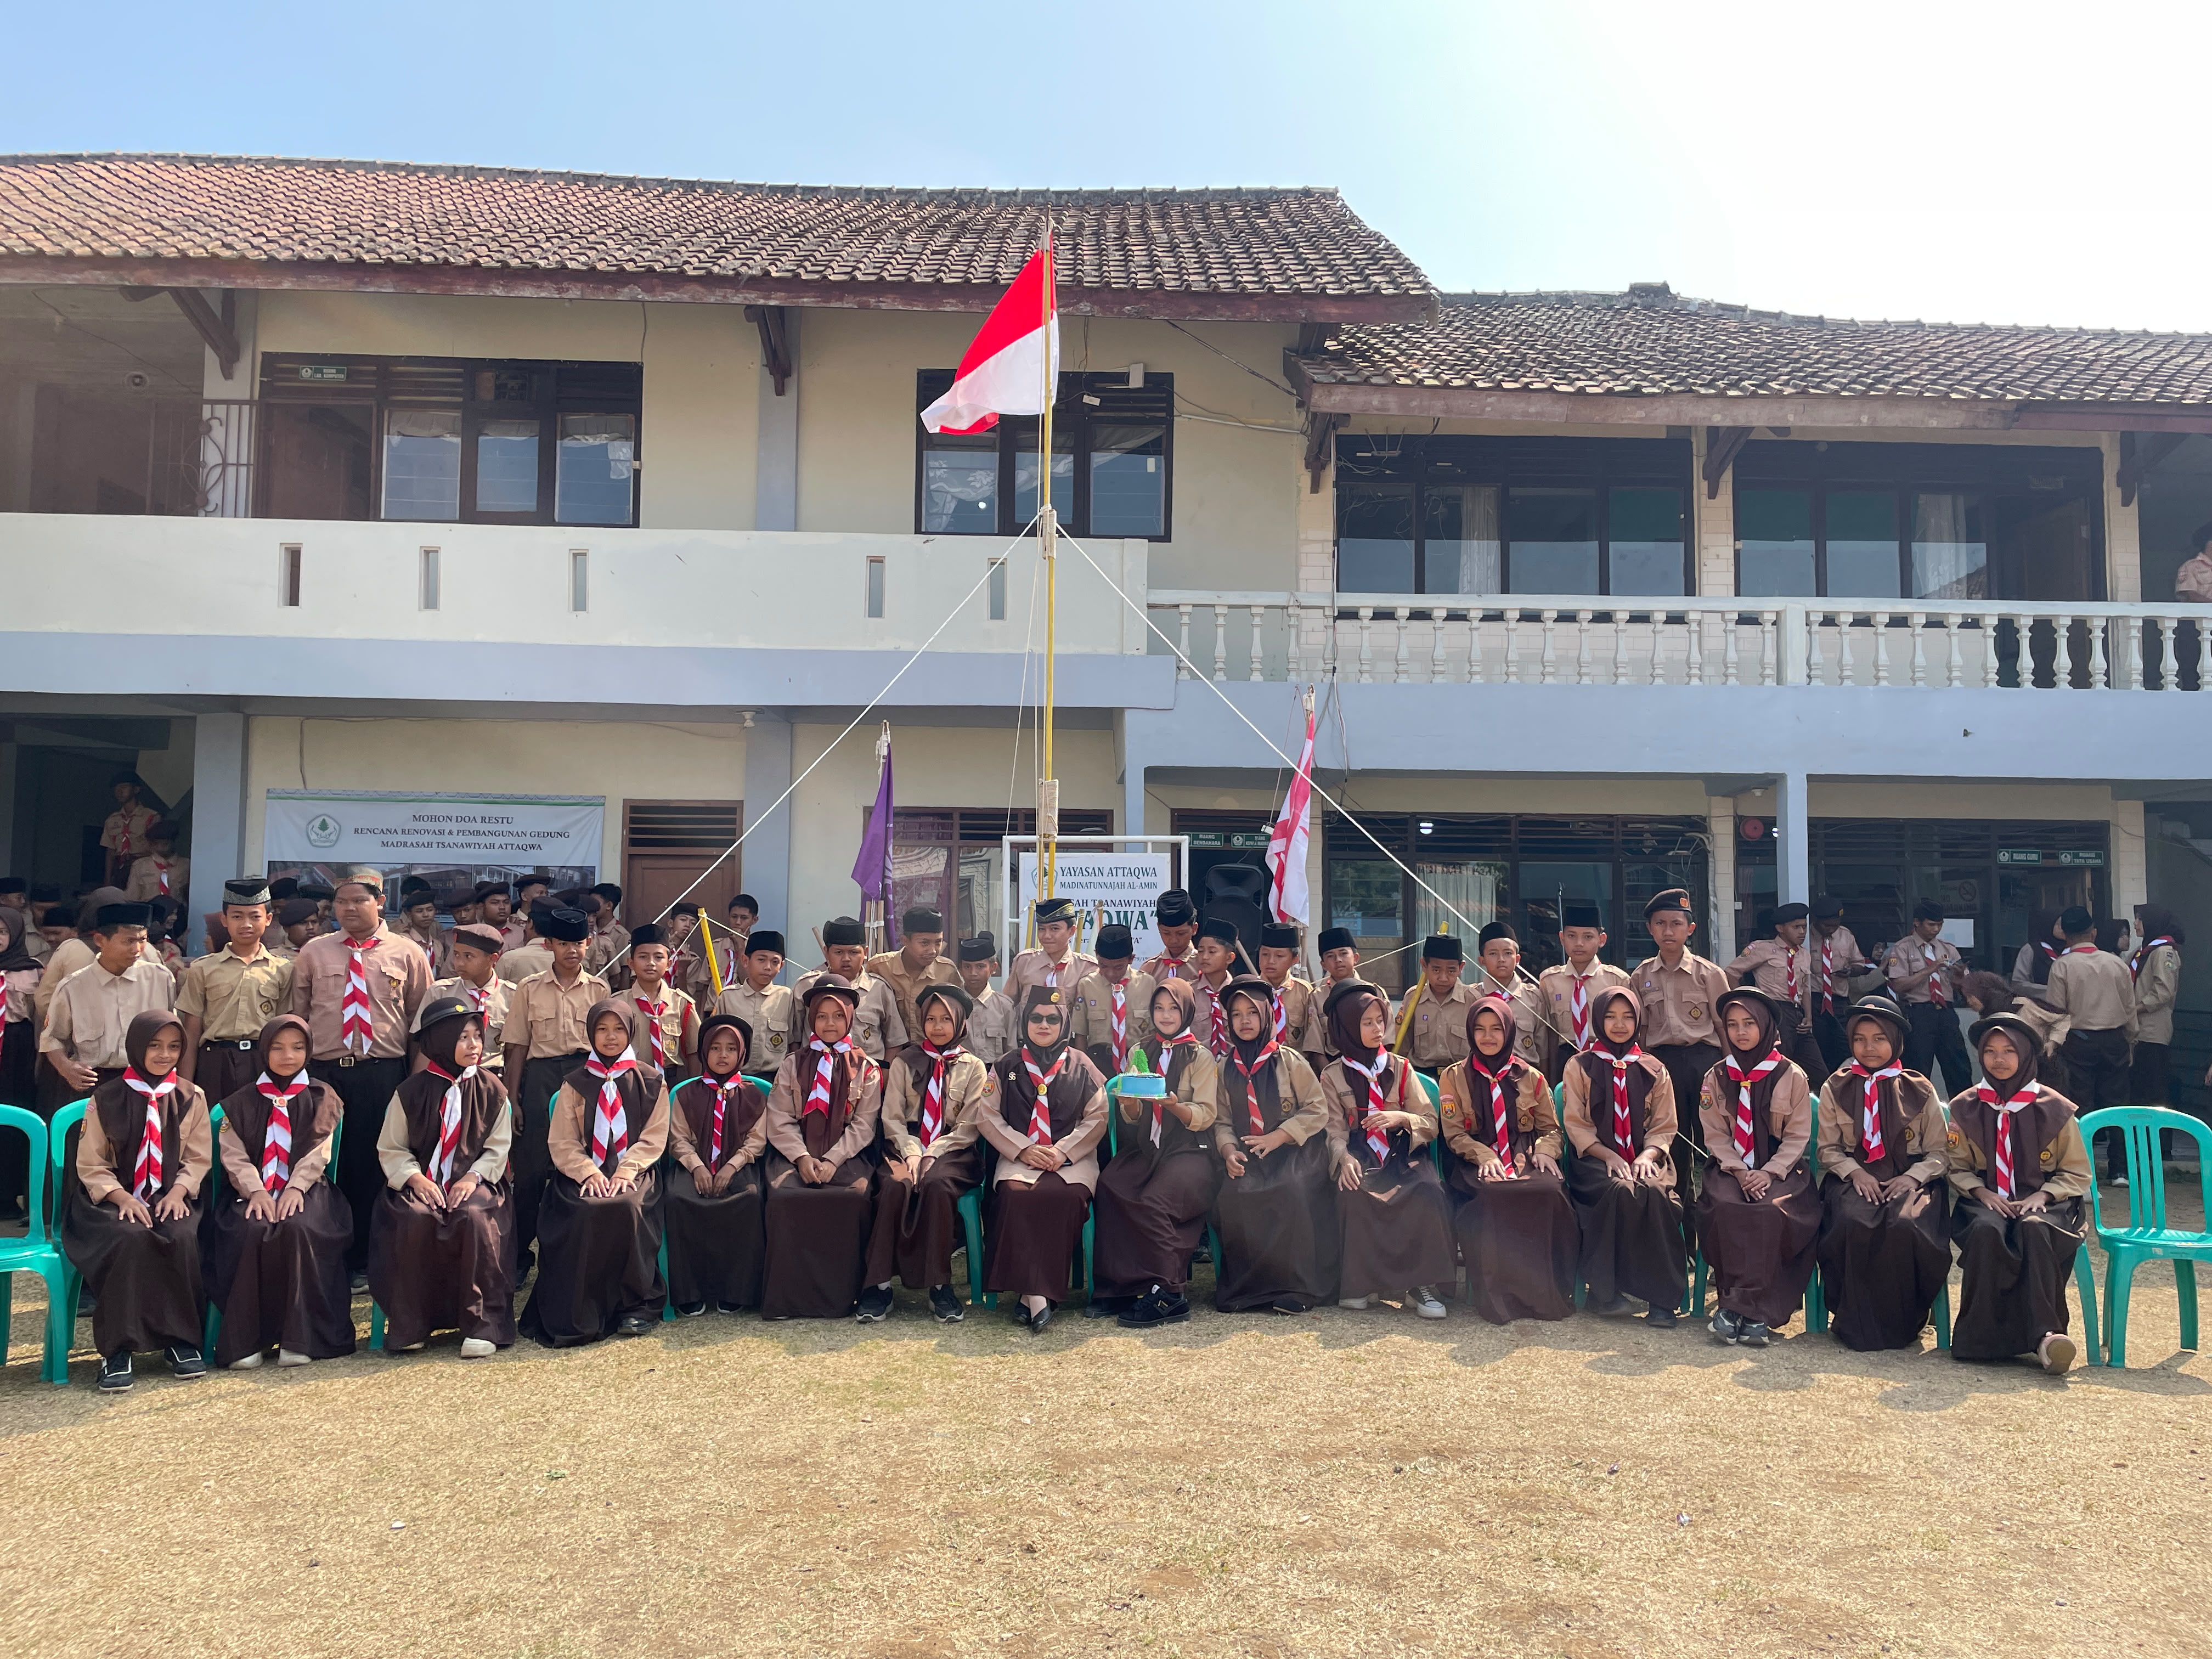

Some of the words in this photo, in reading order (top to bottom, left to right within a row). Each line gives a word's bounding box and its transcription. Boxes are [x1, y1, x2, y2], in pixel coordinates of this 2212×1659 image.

[413, 814, 453, 823] MOHON
[455, 815, 478, 823] DOA
[481, 816, 514, 825] RESTU
[456, 830, 527, 838] PEMBANGUNAN
[436, 842, 495, 850] TSANAWIYAH
[497, 843, 543, 851] ATTAQWA
[1060, 866, 1104, 877] YAYASAN
[1107, 867, 1158, 879] ATTAQWA
[1060, 882, 1125, 890] MADINATUNNAJAH
[1091, 899, 1156, 907] TANAWIYAH
